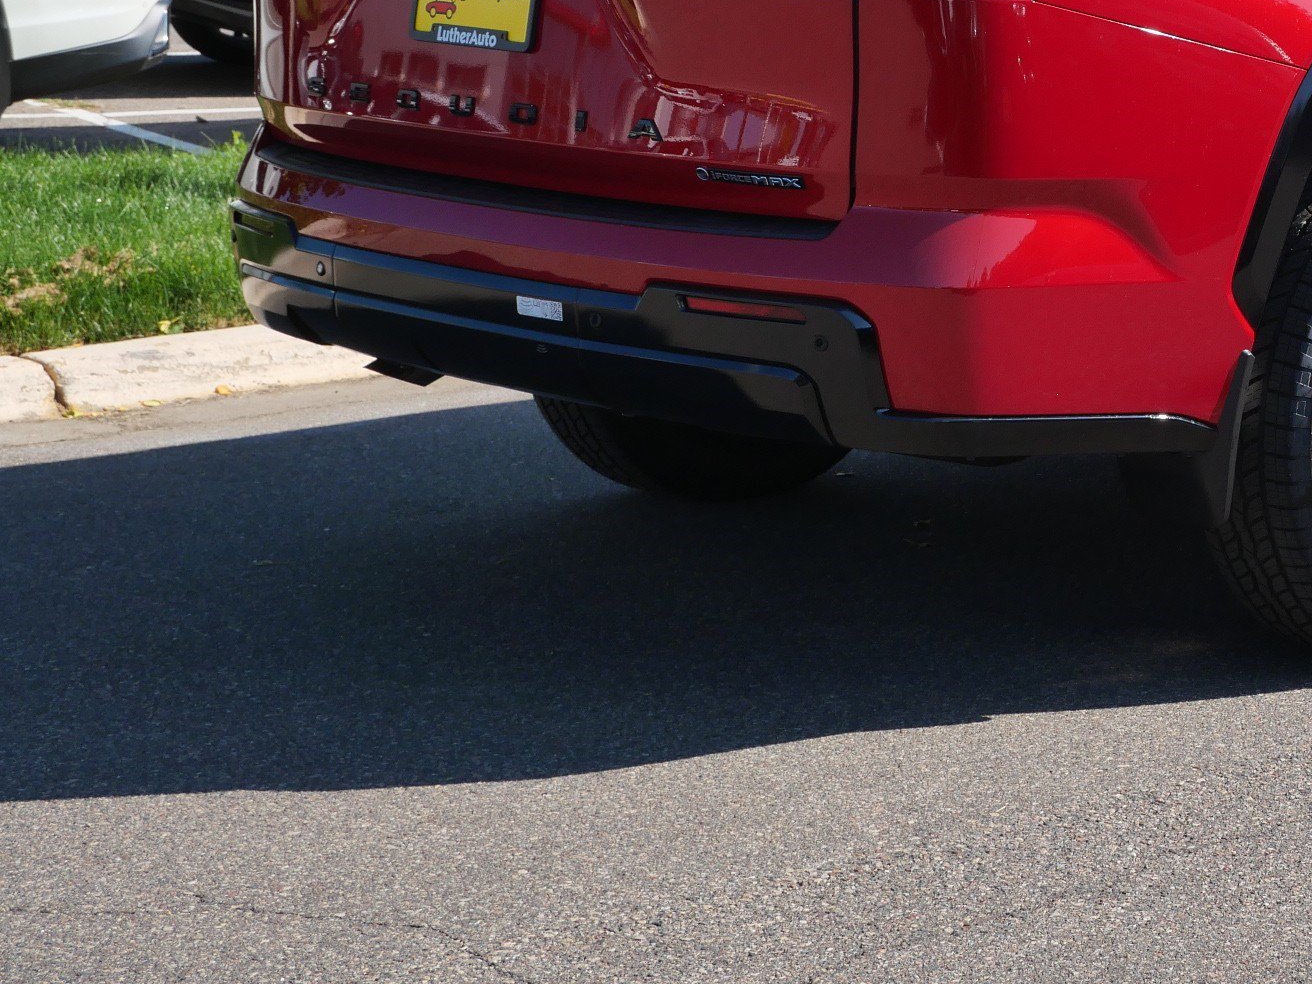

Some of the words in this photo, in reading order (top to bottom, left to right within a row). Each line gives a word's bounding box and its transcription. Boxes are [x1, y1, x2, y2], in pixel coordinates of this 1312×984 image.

[436, 25, 498, 47] LutherAuto
[307, 76, 663, 142] SEQUOIA
[751, 175, 801, 188] MAX
